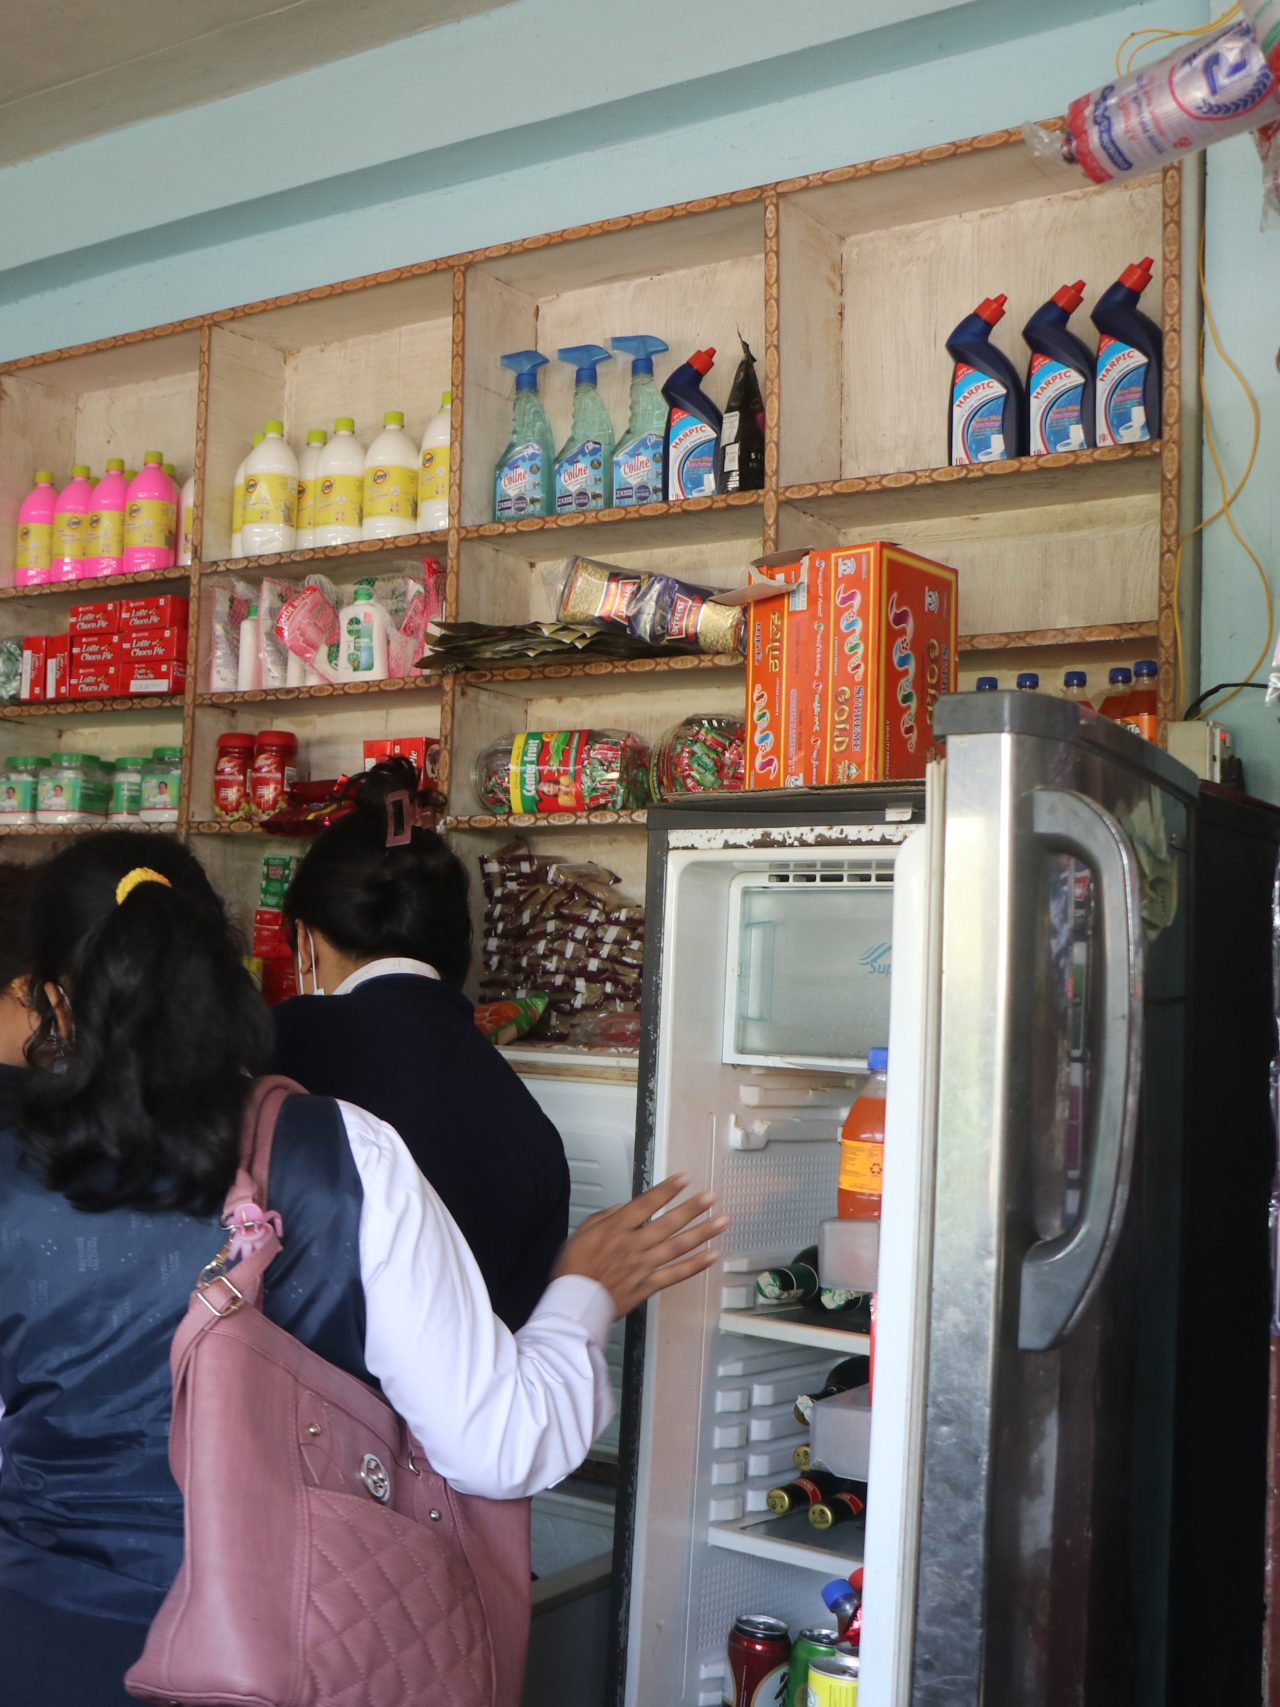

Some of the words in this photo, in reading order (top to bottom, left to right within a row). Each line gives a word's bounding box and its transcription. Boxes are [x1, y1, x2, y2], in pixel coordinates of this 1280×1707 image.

[1100, 350, 1135, 382] HARPIC
[1033, 369, 1072, 400] HARPIC
[955, 380, 995, 408] HARPIC
[672, 425, 707, 449] HARPIC
[78, 612, 96, 622] Lotte
[130, 608, 148, 618] Lotte
[76, 621, 97, 630] Choco
[97, 620, 109, 628] Pie
[129, 616, 149, 626] Choco
[149, 615, 160, 624] Pie
[81, 644, 100, 653] Lotte
[132, 639, 151, 649] Lotte
[80, 652, 101, 661] Choco
[101, 651, 113, 660] Pie
[131, 647, 153, 657] Choco
[153, 647, 165, 656] Pie
[79, 675, 97, 684] Lotte
[78, 683, 98, 693] Choco
[97, 683, 109, 692] Pie
[833, 686, 851, 752] GOLD
[852, 686, 864, 751] SUPREME
[524, 738, 540, 761] fruit
[522, 764, 537, 796] Center
